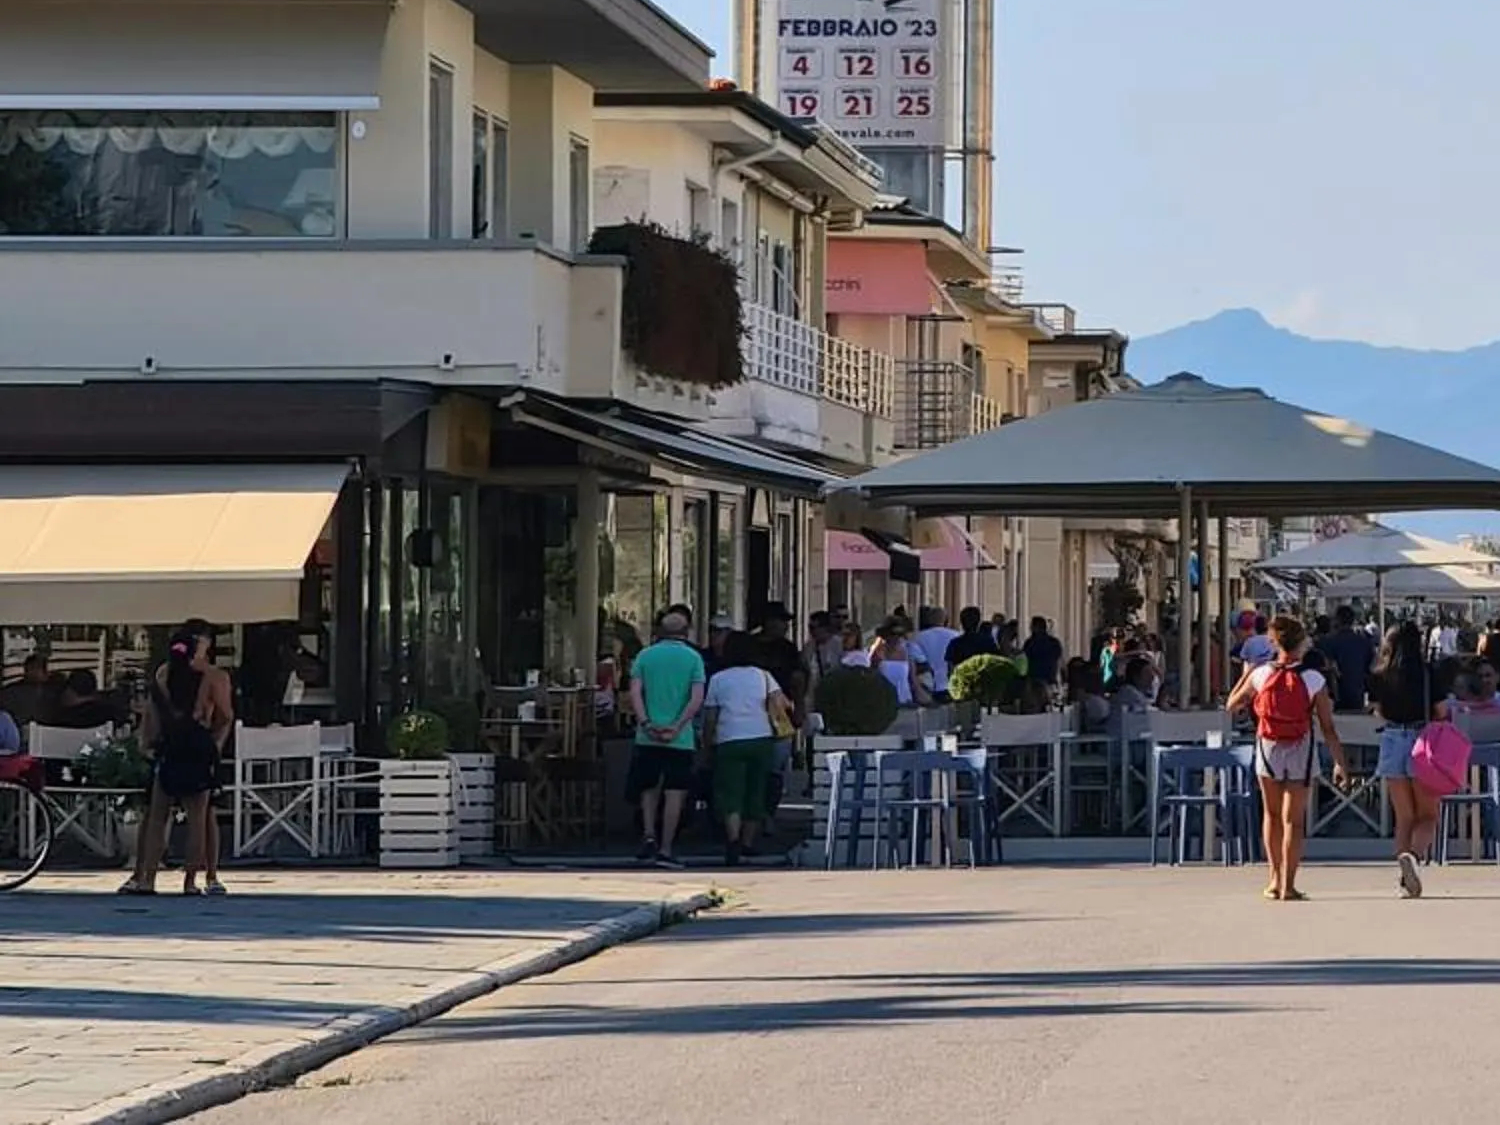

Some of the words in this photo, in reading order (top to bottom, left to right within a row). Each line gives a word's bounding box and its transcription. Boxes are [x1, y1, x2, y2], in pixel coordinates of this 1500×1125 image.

[778, 18, 898, 38] FEBBRAIO
[791, 55, 810, 76] 4
[843, 55, 875, 76] 12
[900, 55, 932, 76] 16
[786, 95, 818, 116] 19
[844, 95, 873, 116] 21
[897, 95, 931, 116] 25
